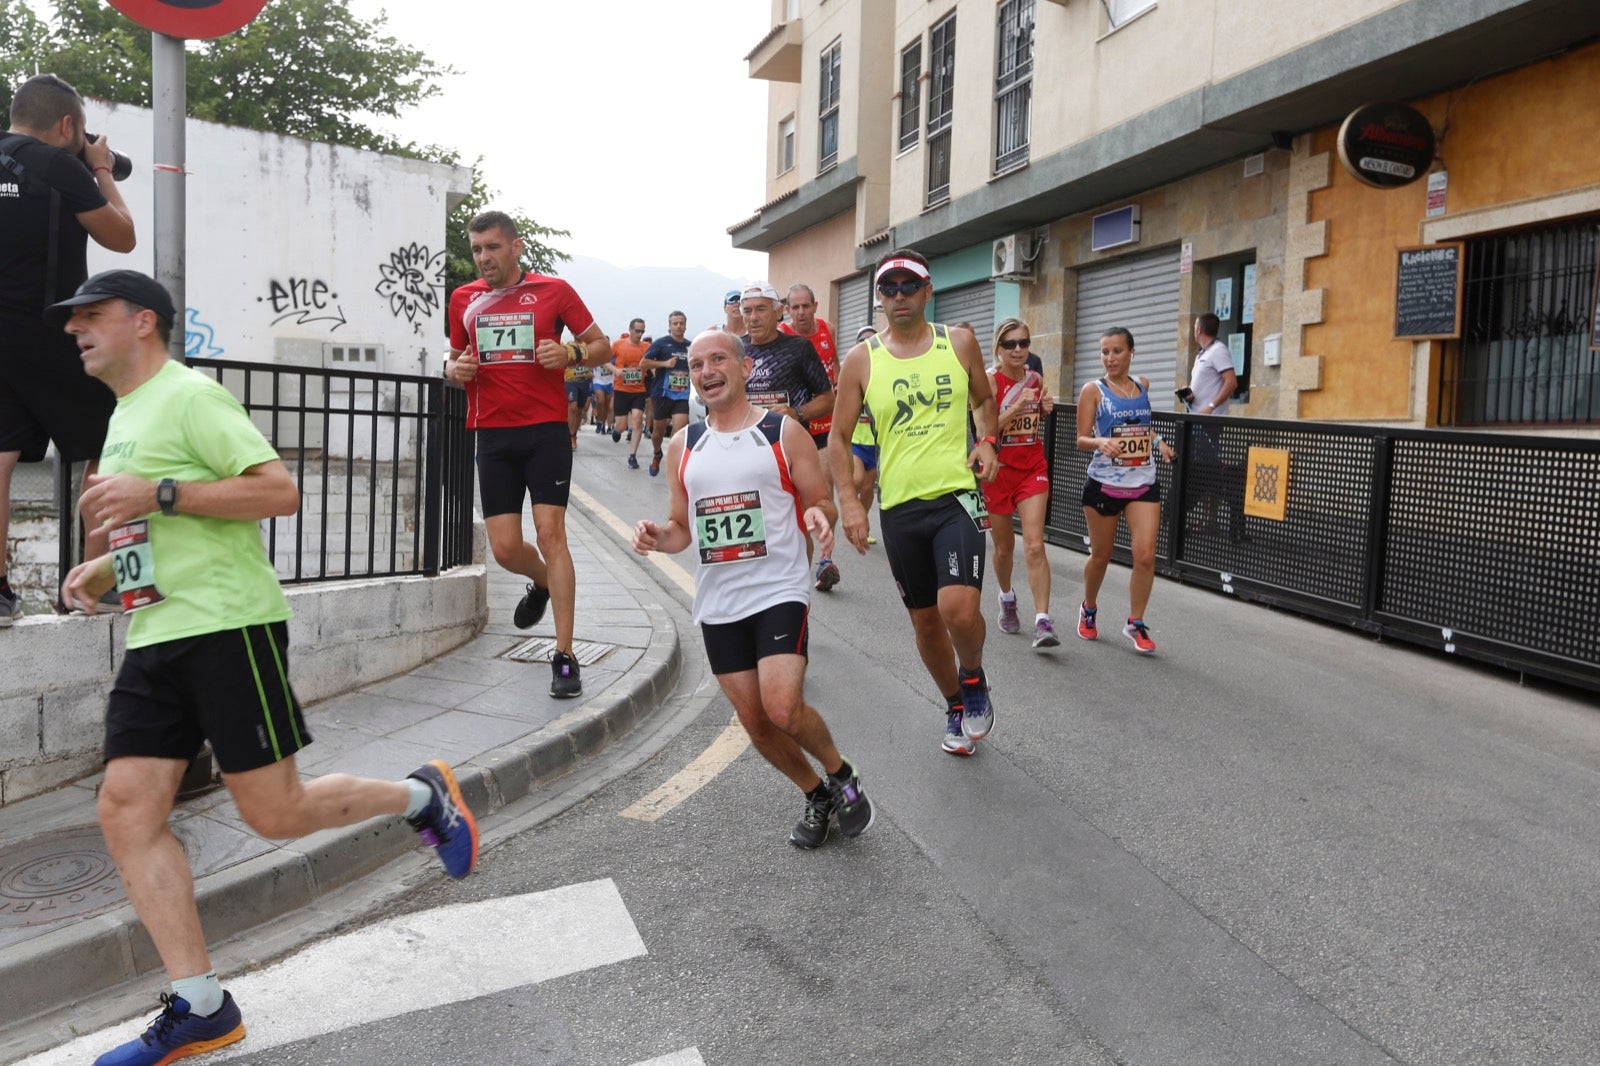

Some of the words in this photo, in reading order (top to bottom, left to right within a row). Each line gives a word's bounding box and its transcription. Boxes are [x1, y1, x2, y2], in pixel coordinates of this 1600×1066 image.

[493, 328, 516, 346] 71
[1112, 410, 1134, 419] TODO
[1009, 416, 1038, 431] 2084
[1118, 439, 1150, 454] 2047
[705, 513, 754, 543] 512
